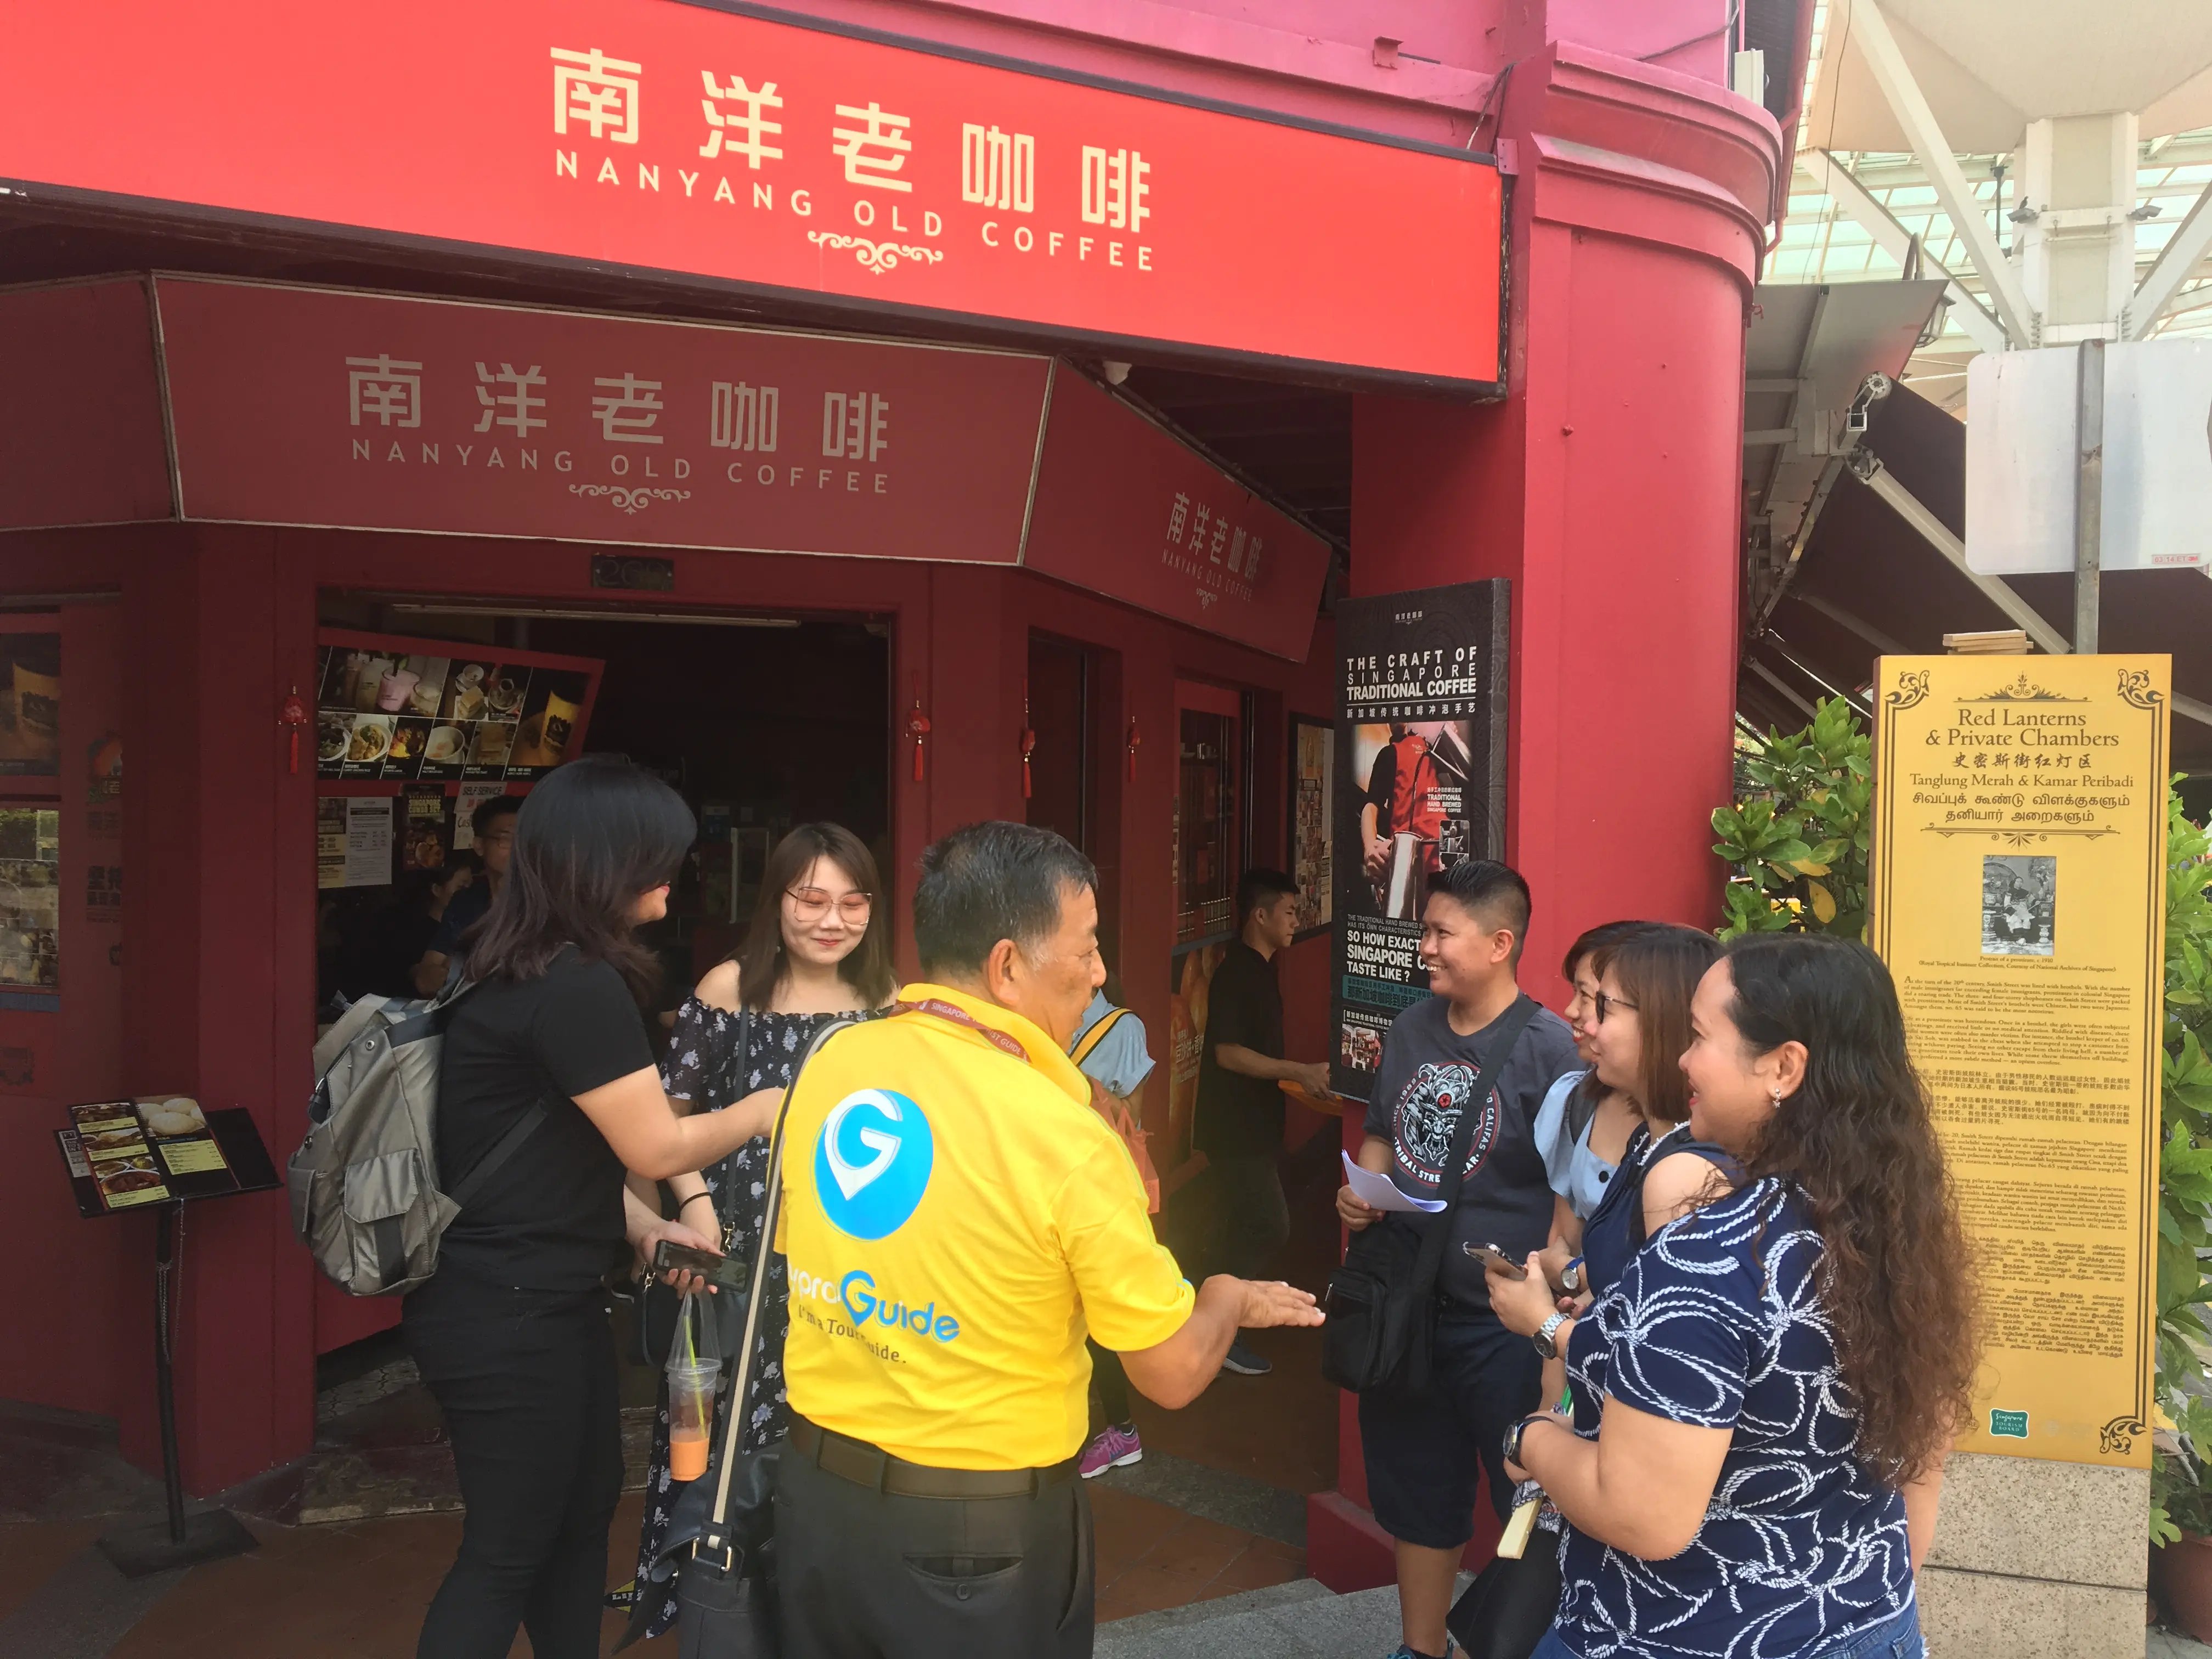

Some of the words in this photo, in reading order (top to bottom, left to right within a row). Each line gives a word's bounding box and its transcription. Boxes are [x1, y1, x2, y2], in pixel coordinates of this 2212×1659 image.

[550, 47, 1151, 233] 南洋老咖啡
[555, 149, 812, 216] NANYANG
[854, 199, 943, 237] OLD
[981, 221, 1153, 271] COFFEE
[345, 353, 890, 462] 南洋老咖啡
[352, 439, 573, 472] NANYANG
[611, 454, 691, 479] OLD
[727, 462, 888, 494] COFFEE
[1161, 549, 1203, 579] NANYANG
[1206, 569, 1222, 588] OLD
[1226, 579, 1252, 602] COFFEE
[1347, 656, 1376, 671] THE
[1387, 650, 1443, 668] CRAFT
[1455, 646, 1477, 662] OF
[1347, 663, 1476, 685] SINGAPORE
[1346, 681, 1423, 701] TRADITIONAL
[1427, 678, 1476, 696] COFFEE
[1958, 708, 1996, 726] Red
[2002, 709, 2086, 726] Lanterns
[1926, 730, 1940, 746] &
[1948, 729, 2012, 746] Private
[2020, 728, 2119, 746] Chambers
[1952, 752, 2091, 769] 史密斯街红灯区
[1910, 773, 1968, 789] Tanglung
[1971, 774, 2013, 786] Merah
[2018, 775, 2029, 786] &
[2033, 775, 2078, 787] Kamar
[2082, 775, 2134, 787] Peribadi
[1912, 792, 1967, 806] சிவப்புக்
[1357, 915, 1385, 924] TRADITIONAL
[1398, 920, 1418, 928] BREWED
[1378, 925, 1421, 936] CHARACTERISTICS
[1347, 930, 1360, 942] SO
[1363, 932, 1385, 946] HOW
[1347, 944, 1412, 968] SINGAPORE
[1347, 961, 1376, 977] TASTE
[1379, 966, 1402, 981] LIKE
[1404, 970, 1410, 982] ?
[931, 1003, 970, 1020] SINGAPORE
[1000, 1039, 1021, 1054] GUIDE
[1479, 1107, 1494, 1150] CALIFAS
[1395, 1138, 1417, 1173] TRIBAL
